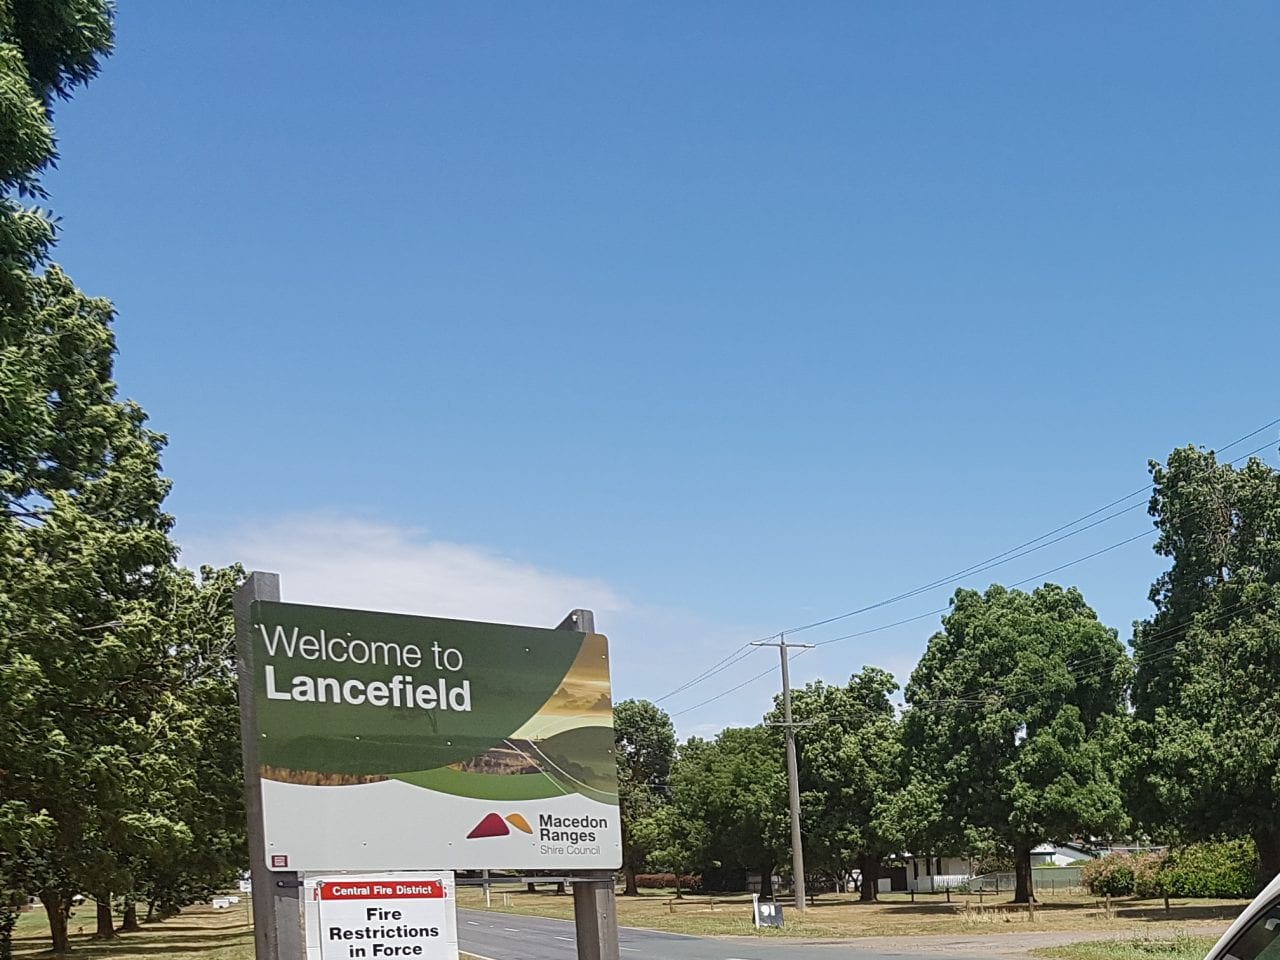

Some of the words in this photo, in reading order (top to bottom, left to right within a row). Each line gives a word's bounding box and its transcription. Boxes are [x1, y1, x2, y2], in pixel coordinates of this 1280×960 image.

[260, 624, 422, 668] Welcome
[431, 641, 463, 672] to
[265, 665, 472, 712] Lancefield
[539, 814, 608, 828] Macedon
[540, 828, 596, 844] Ranges
[540, 844, 564, 855] Shire
[567, 845, 601, 855] Council
[332, 885, 370, 896] Central
[373, 885, 393, 895] Fire
[396, 885, 432, 895] District
[366, 907, 402, 921] Fire
[329, 925, 440, 941] Restrictions
[349, 944, 366, 958] in
[373, 944, 423, 957] Force
